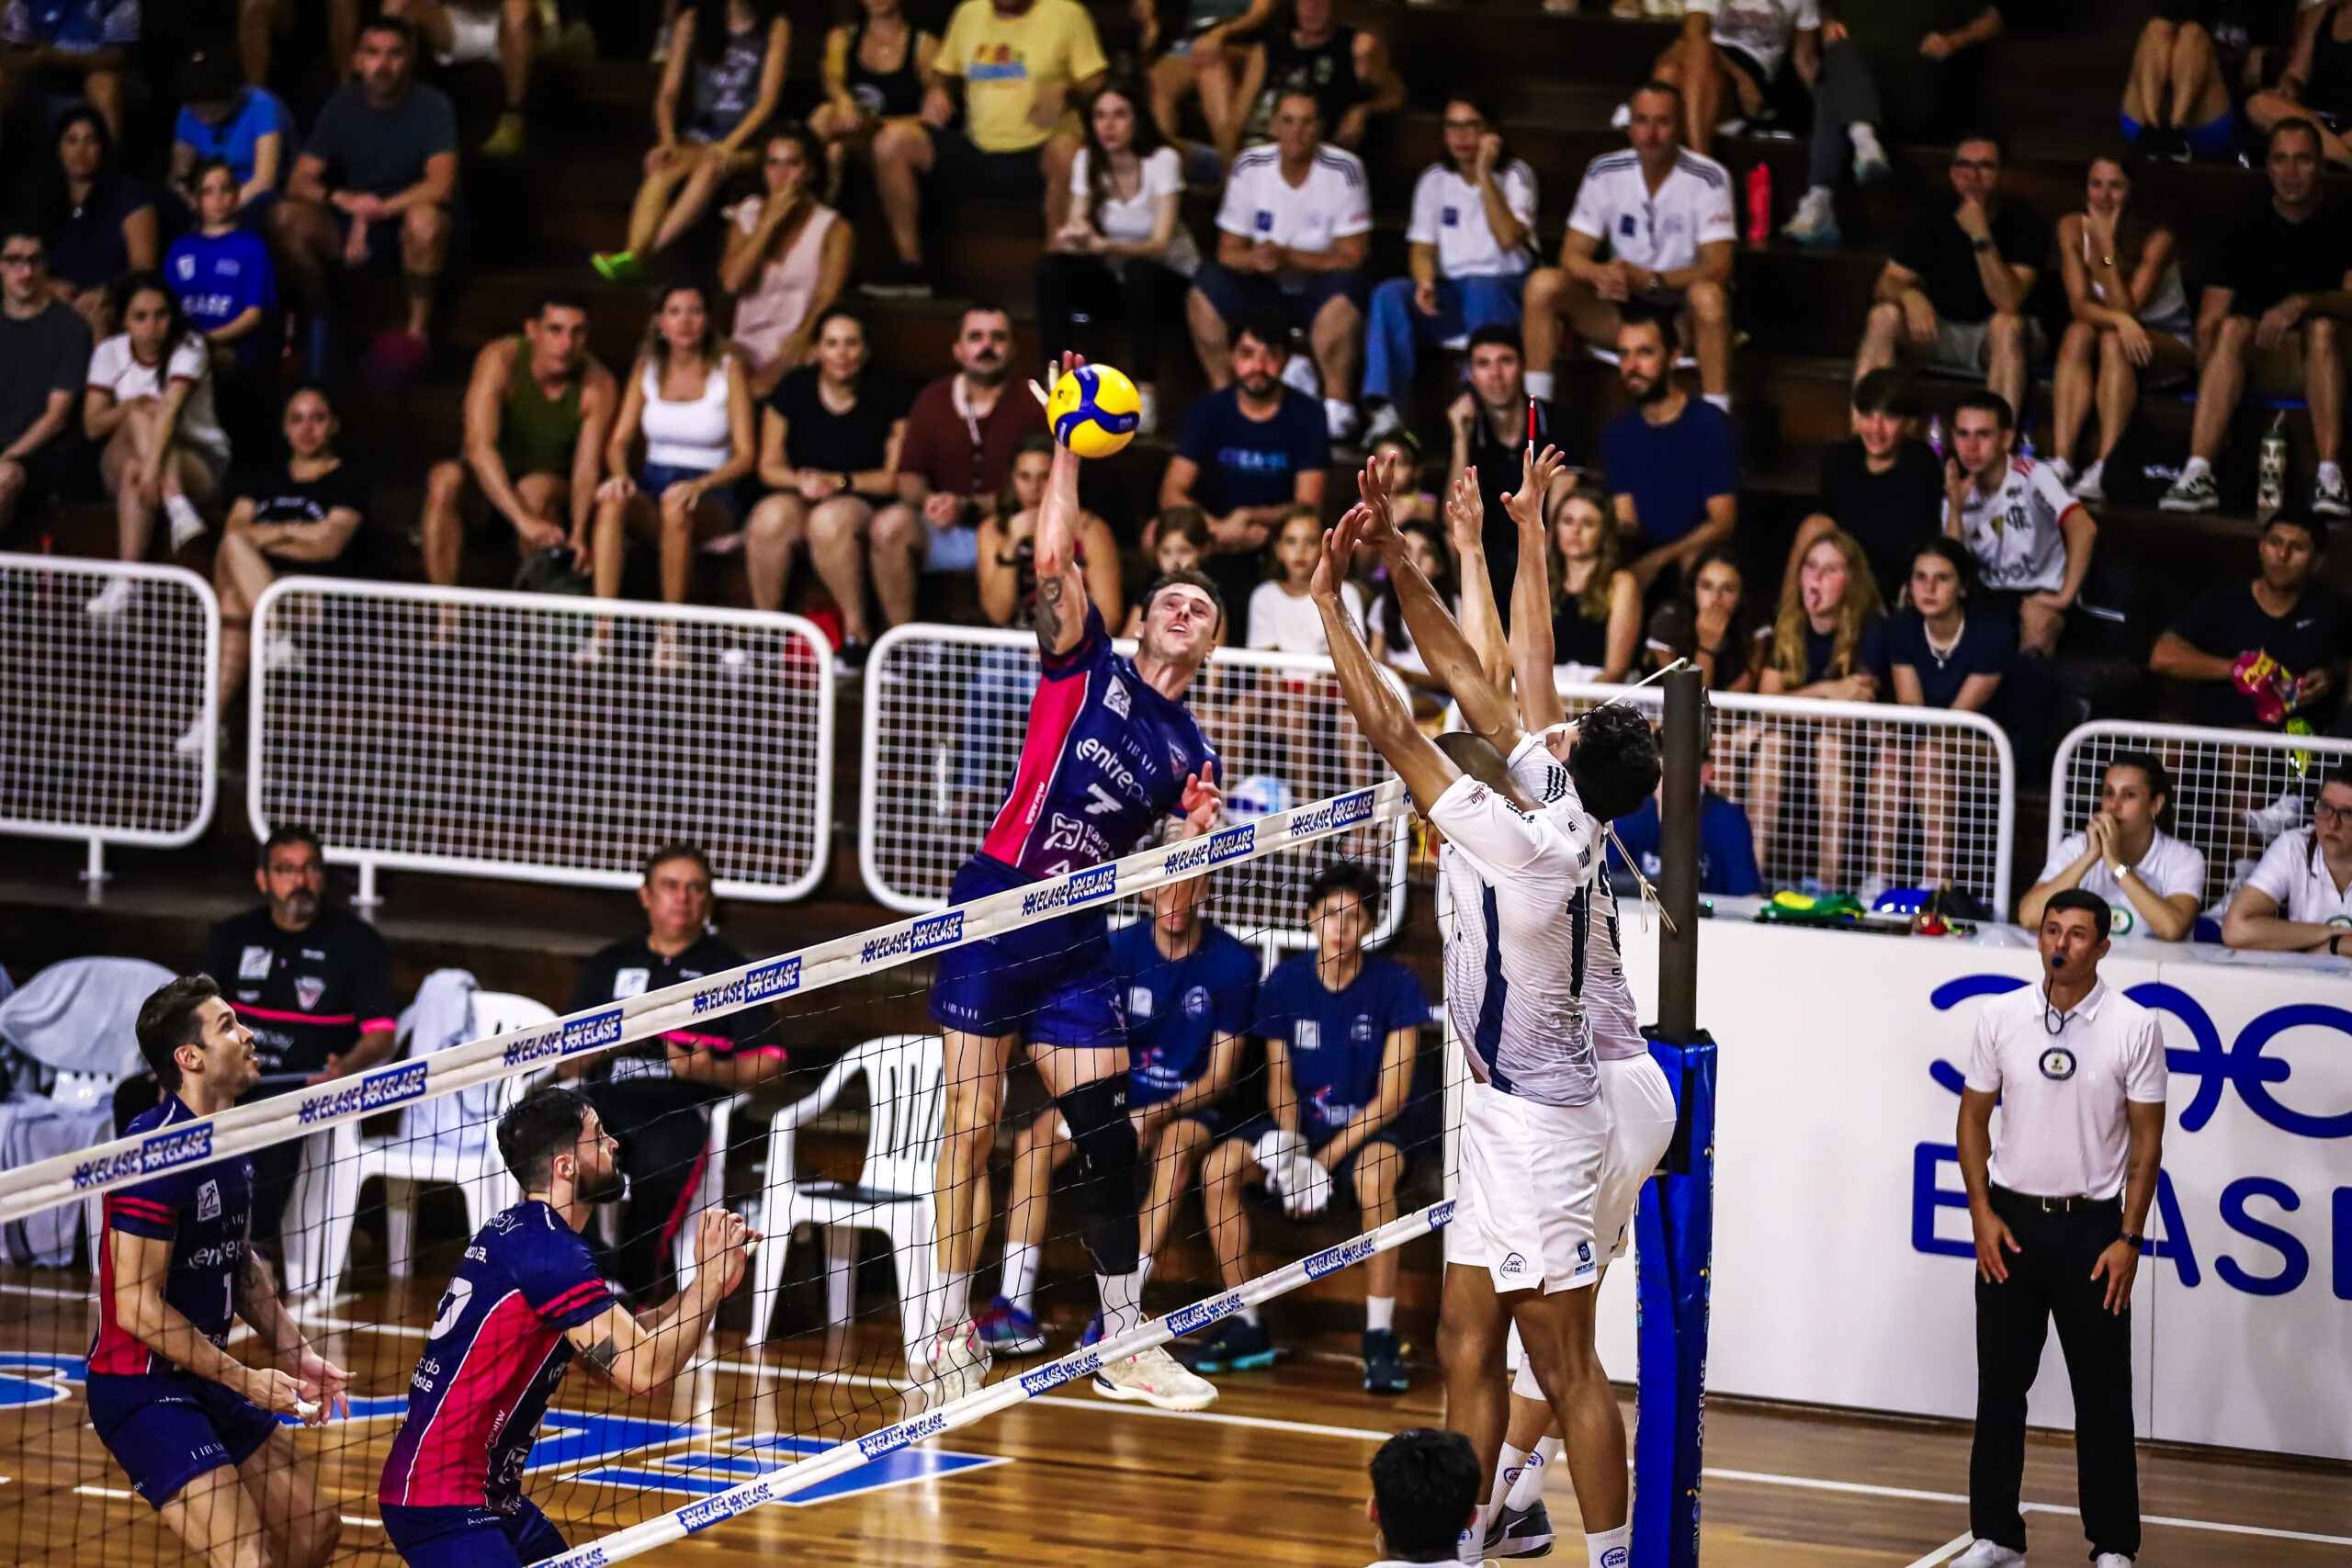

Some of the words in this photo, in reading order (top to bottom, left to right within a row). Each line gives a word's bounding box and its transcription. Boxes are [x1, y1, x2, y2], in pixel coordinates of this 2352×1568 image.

[1084, 783, 1123, 815] 7
[1305, 808, 1330, 833] ELASE
[1345, 795, 1373, 821] ELASE
[1180, 844, 1208, 871] ELASE
[1224, 829, 1253, 854] ELASE
[1036, 884, 1069, 912] ELASE
[1085, 869, 1114, 896] ELASE
[876, 931, 911, 958] ELASE
[929, 916, 962, 943] ELASE
[710, 979, 744, 1010] ELASE
[764, 962, 799, 991] ELASE
[523, 1031, 560, 1062] ELASE
[584, 1014, 621, 1043] ELASE
[322, 1086, 360, 1120] ELASE
[385, 1067, 425, 1102] ELASE
